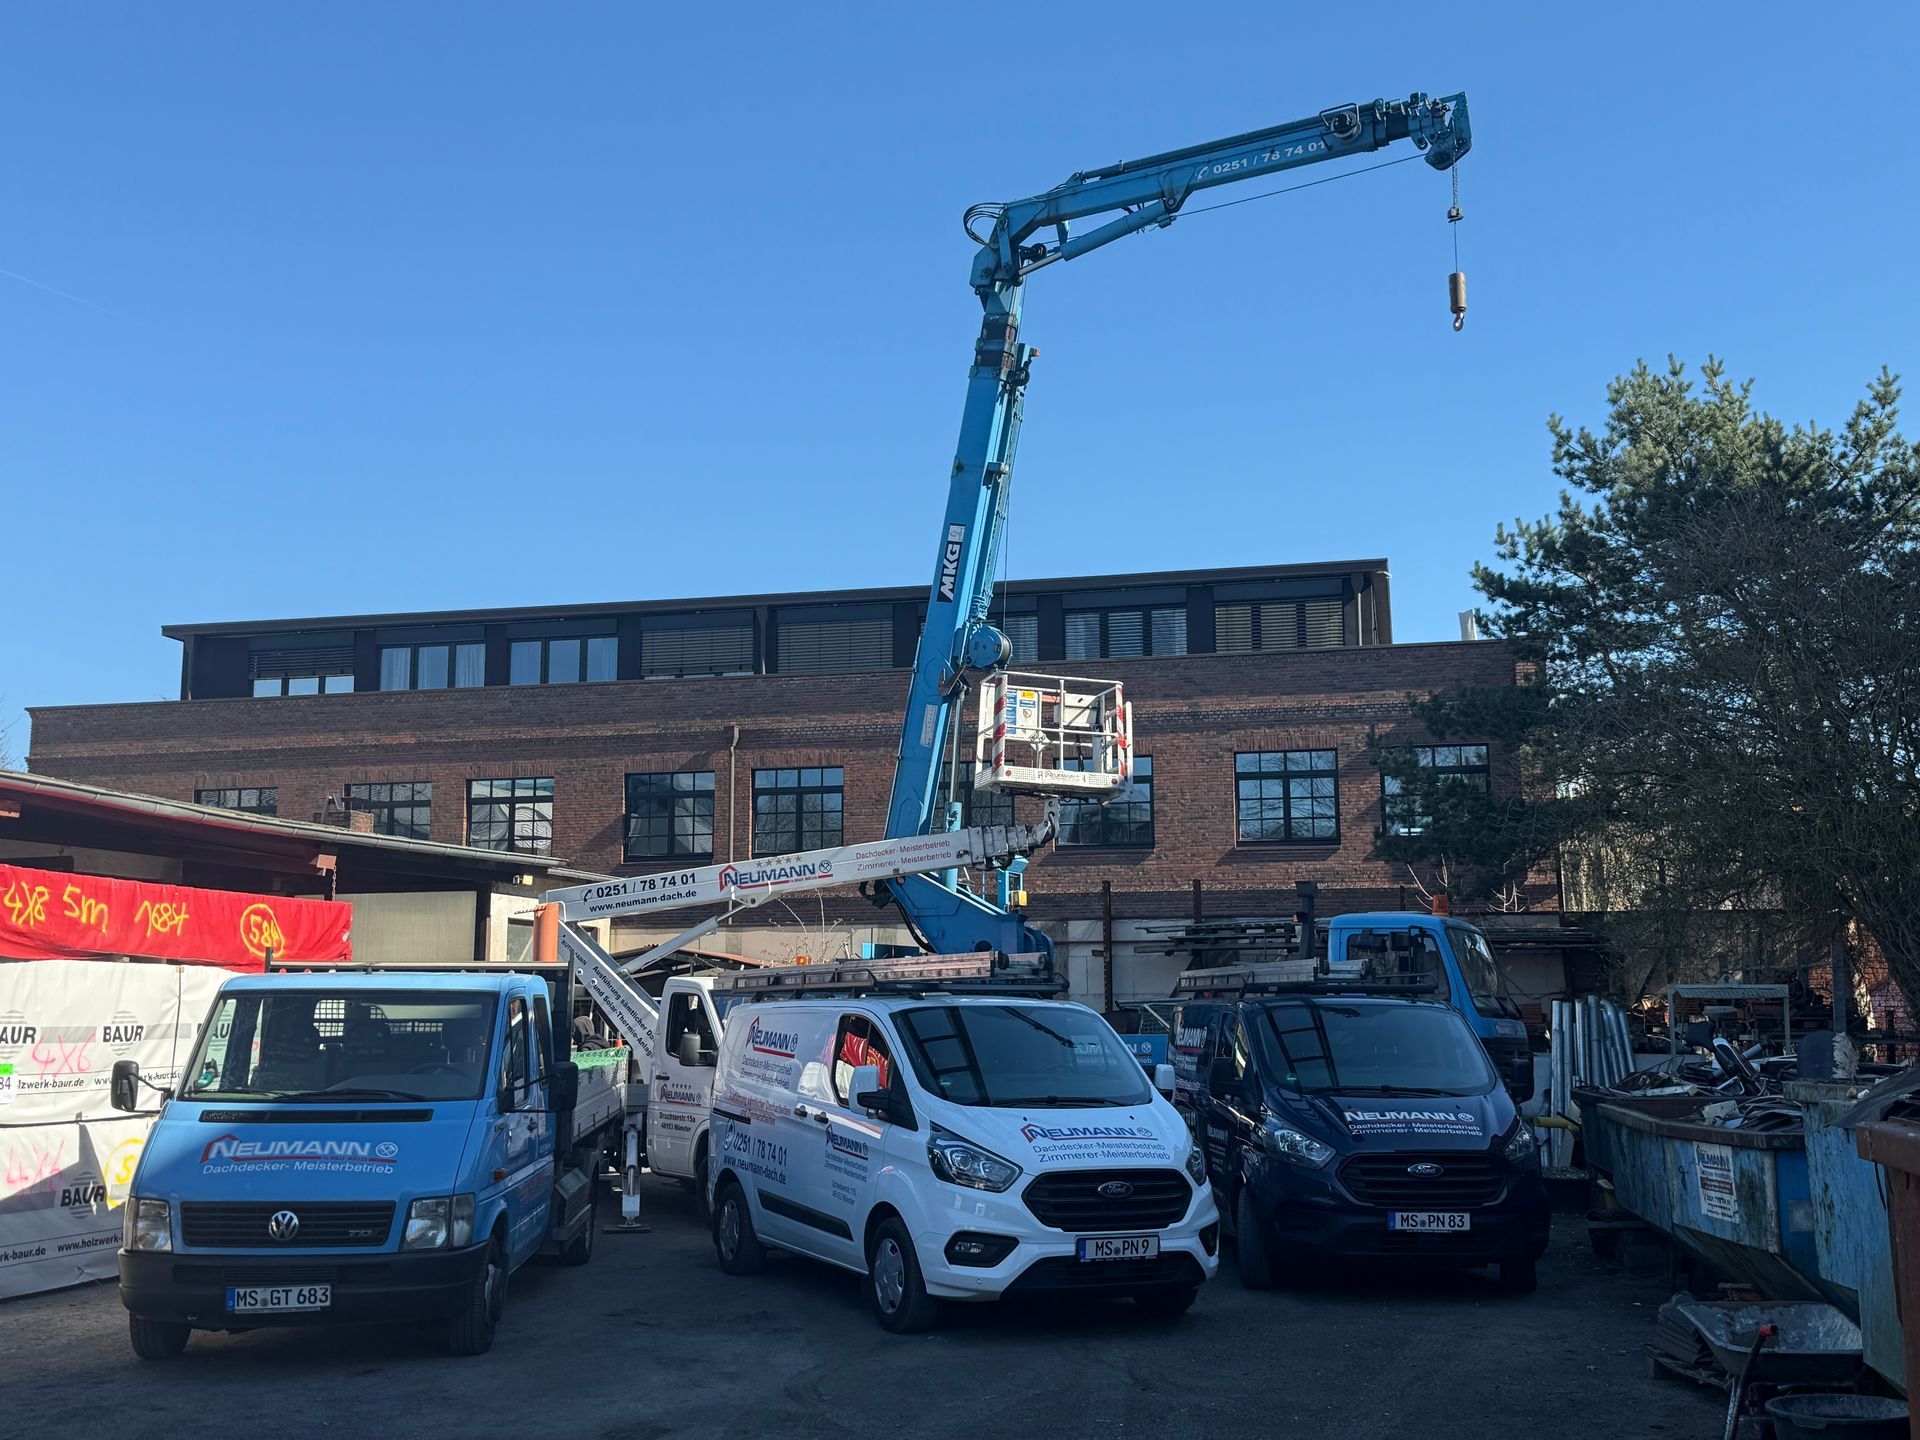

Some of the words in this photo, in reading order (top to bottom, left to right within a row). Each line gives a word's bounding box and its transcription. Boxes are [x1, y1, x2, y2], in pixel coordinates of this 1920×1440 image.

[1213, 159, 1248, 174] 0251
[1262, 151, 1280, 163] 78
[1285, 144, 1304, 157] 74
[1308, 141, 1326, 152] 01
[940, 543, 960, 600] MKG
[597, 883, 627, 898] 0251
[640, 879, 656, 891] 78
[660, 876, 676, 888] 74
[681, 873, 696, 884] 01
[723, 863, 816, 887] NEUMANN
[589, 890, 697, 912] www.neumann-dach.de
[560, 939, 587, 966] RUTANN
[593, 984, 604, 997] und
[593, 965, 621, 1000] Ausführung
[620, 998, 647, 1033] sämtlicher
[646, 1029, 655, 1041] Da
[102, 1025, 144, 1043] BAUR
[751, 1025, 790, 1049] NEUMANN
[17, 1078, 85, 1090] lzwerk-baur.de
[661, 1087, 696, 1103] NEUMANN
[1344, 1111, 1456, 1121] NEUMANN
[1029, 1126, 1134, 1139] NEUMANN
[209, 1140, 372, 1159] NEUMANN
[734, 1131, 751, 1153] 0251
[758, 1139, 766, 1159] 78
[768, 1142, 776, 1163] 74
[779, 1146, 787, 1167] 01
[294, 1160, 394, 1174] Meisterbetrieb
[723, 1154, 787, 1185] www.neumann-dach.de
[60, 1185, 106, 1207] BAUR
[1400, 1214, 1418, 1228] MS
[1427, 1215, 1445, 1228] PN
[1448, 1215, 1465, 1228] 83
[57, 1233, 123, 1253] www.holzwerk-
[1095, 1241, 1113, 1256] MS
[1122, 1240, 1139, 1255] PN
[1141, 1239, 1150, 1254] 9
[236, 1289, 258, 1307] MS
[270, 1288, 292, 1306] GT
[297, 1286, 329, 1304] 683
